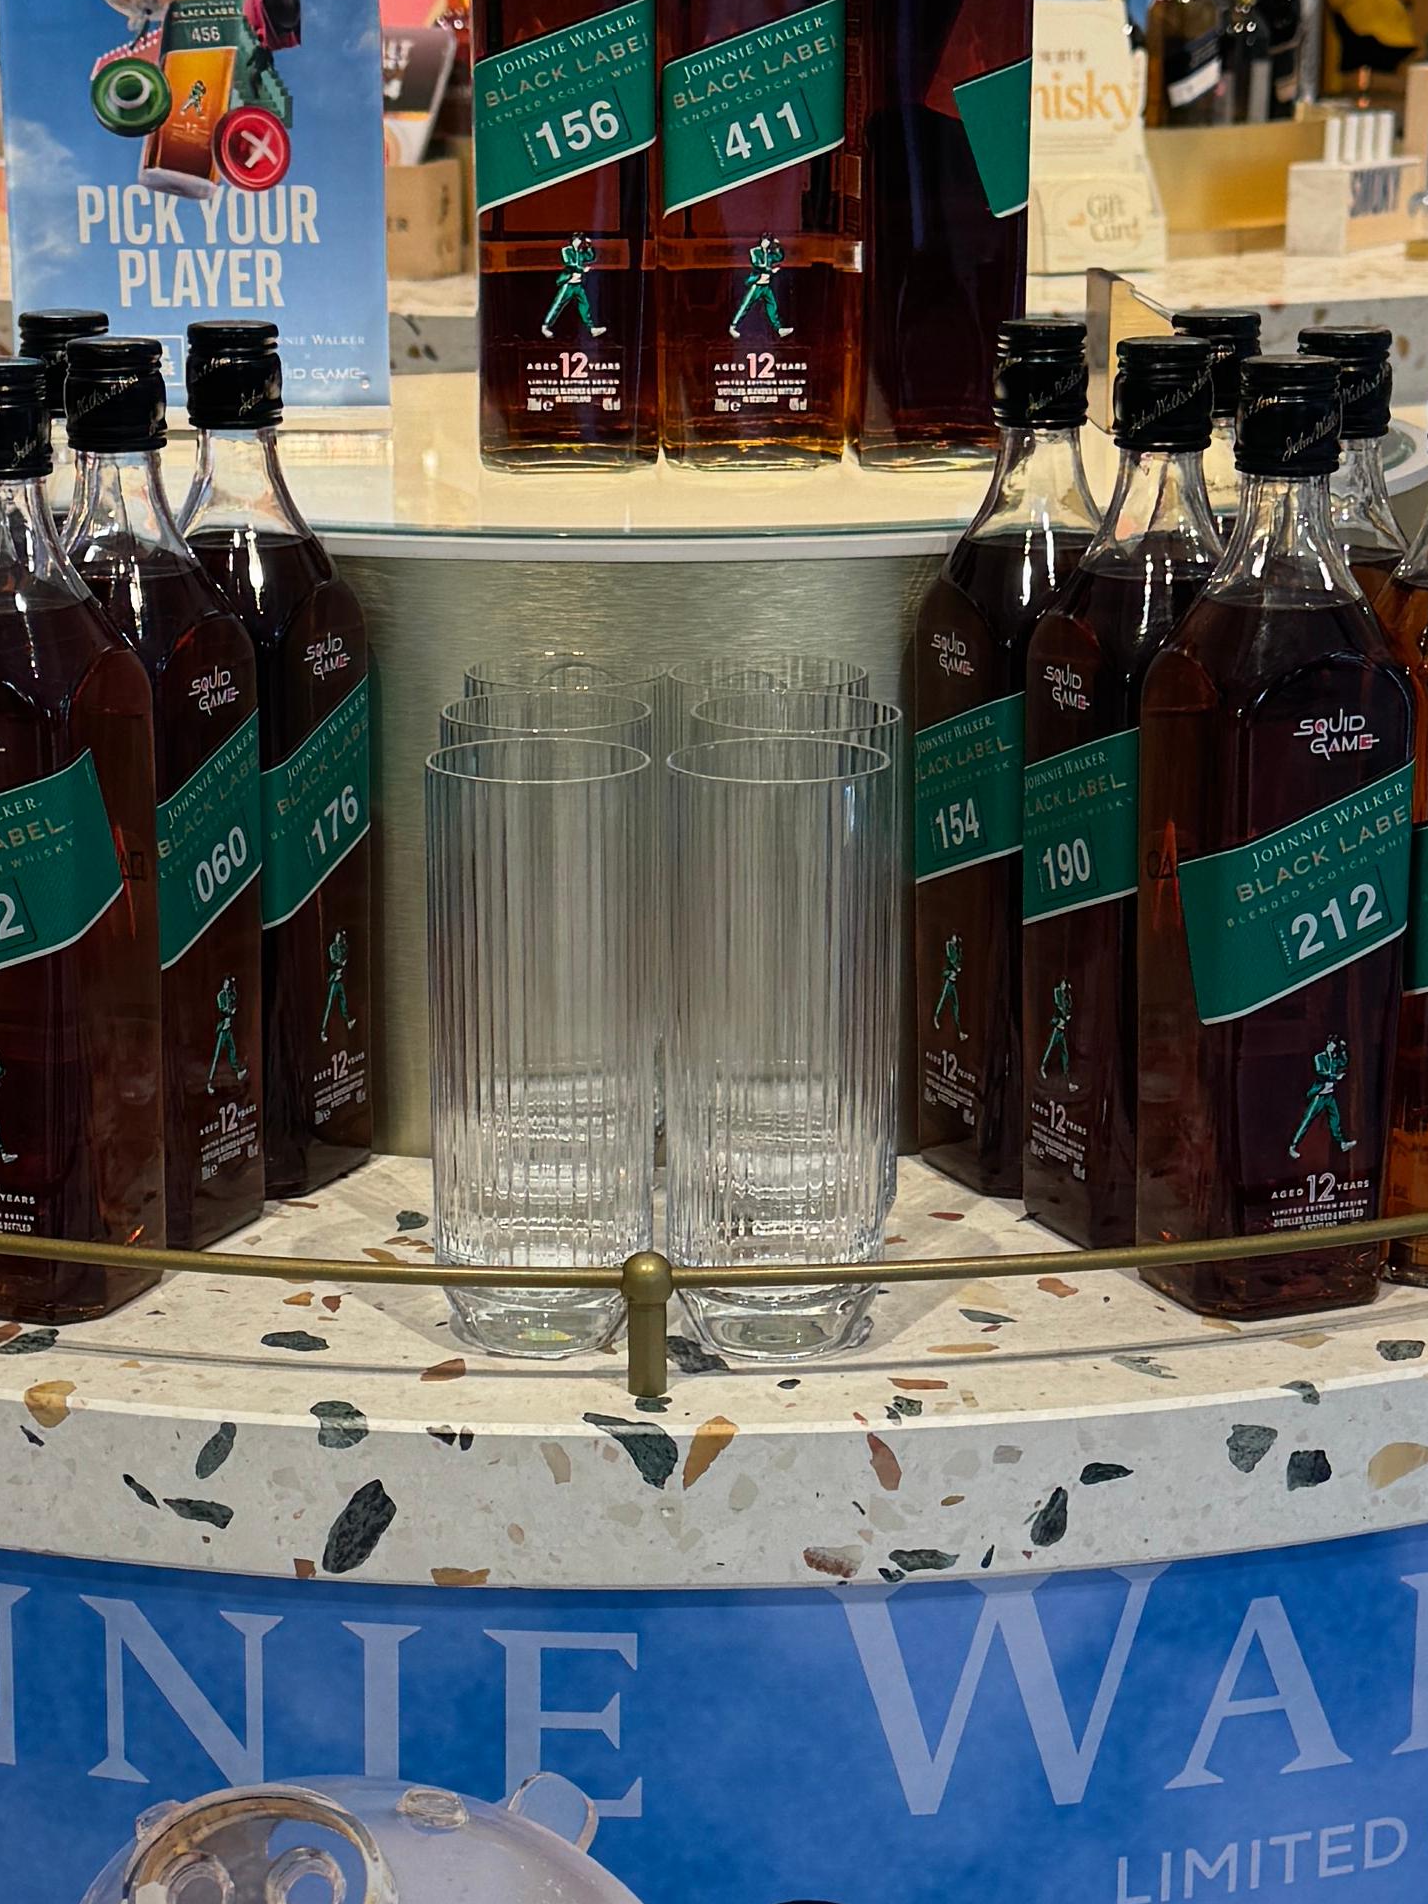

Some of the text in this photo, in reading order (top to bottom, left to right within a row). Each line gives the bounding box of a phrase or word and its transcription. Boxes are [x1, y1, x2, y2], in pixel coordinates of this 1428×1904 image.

[191, 26, 220, 42] 456
[1033, 68, 1138, 132] isky
[535, 100, 619, 159] 156
[725, 101, 802, 160] 411
[77, 184, 320, 244] PICK YOUR
[117, 248, 285, 308] PLAYER
[559, 352, 588, 378] 12
[746, 352, 775, 378] 12
[304, 632, 343, 661] SQUID
[931, 632, 966, 656] SQUID
[313, 653, 351, 680] GAME
[939, 653, 974, 676] GAME
[1043, 664, 1082, 689] SQUID
[189, 665, 231, 698] SQUID
[198, 687, 240, 716] GAME
[1052, 687, 1090, 710] GAME
[1293, 708, 1366, 741] SQUID
[1310, 734, 1380, 761] GAME
[312, 784, 359, 855] 176
[936, 798, 980, 849] 154
[1254, 782, 1406, 872] JOHNNIE WALKER
[196, 826, 247, 902] 060
[1043, 838, 1091, 890] 190
[1236, 845, 1330, 903] BLACK
[1291, 883, 1383, 961] 212
[332, 1050, 348, 1080] 12
[942, 1050, 957, 1082] 12
[219, 1102, 238, 1134] 12
[1049, 1100, 1066, 1134] 12
[0, 1193, 36, 1205] YEARS
[1271, 1172, 1369, 1203] AGED 12 YEARS
